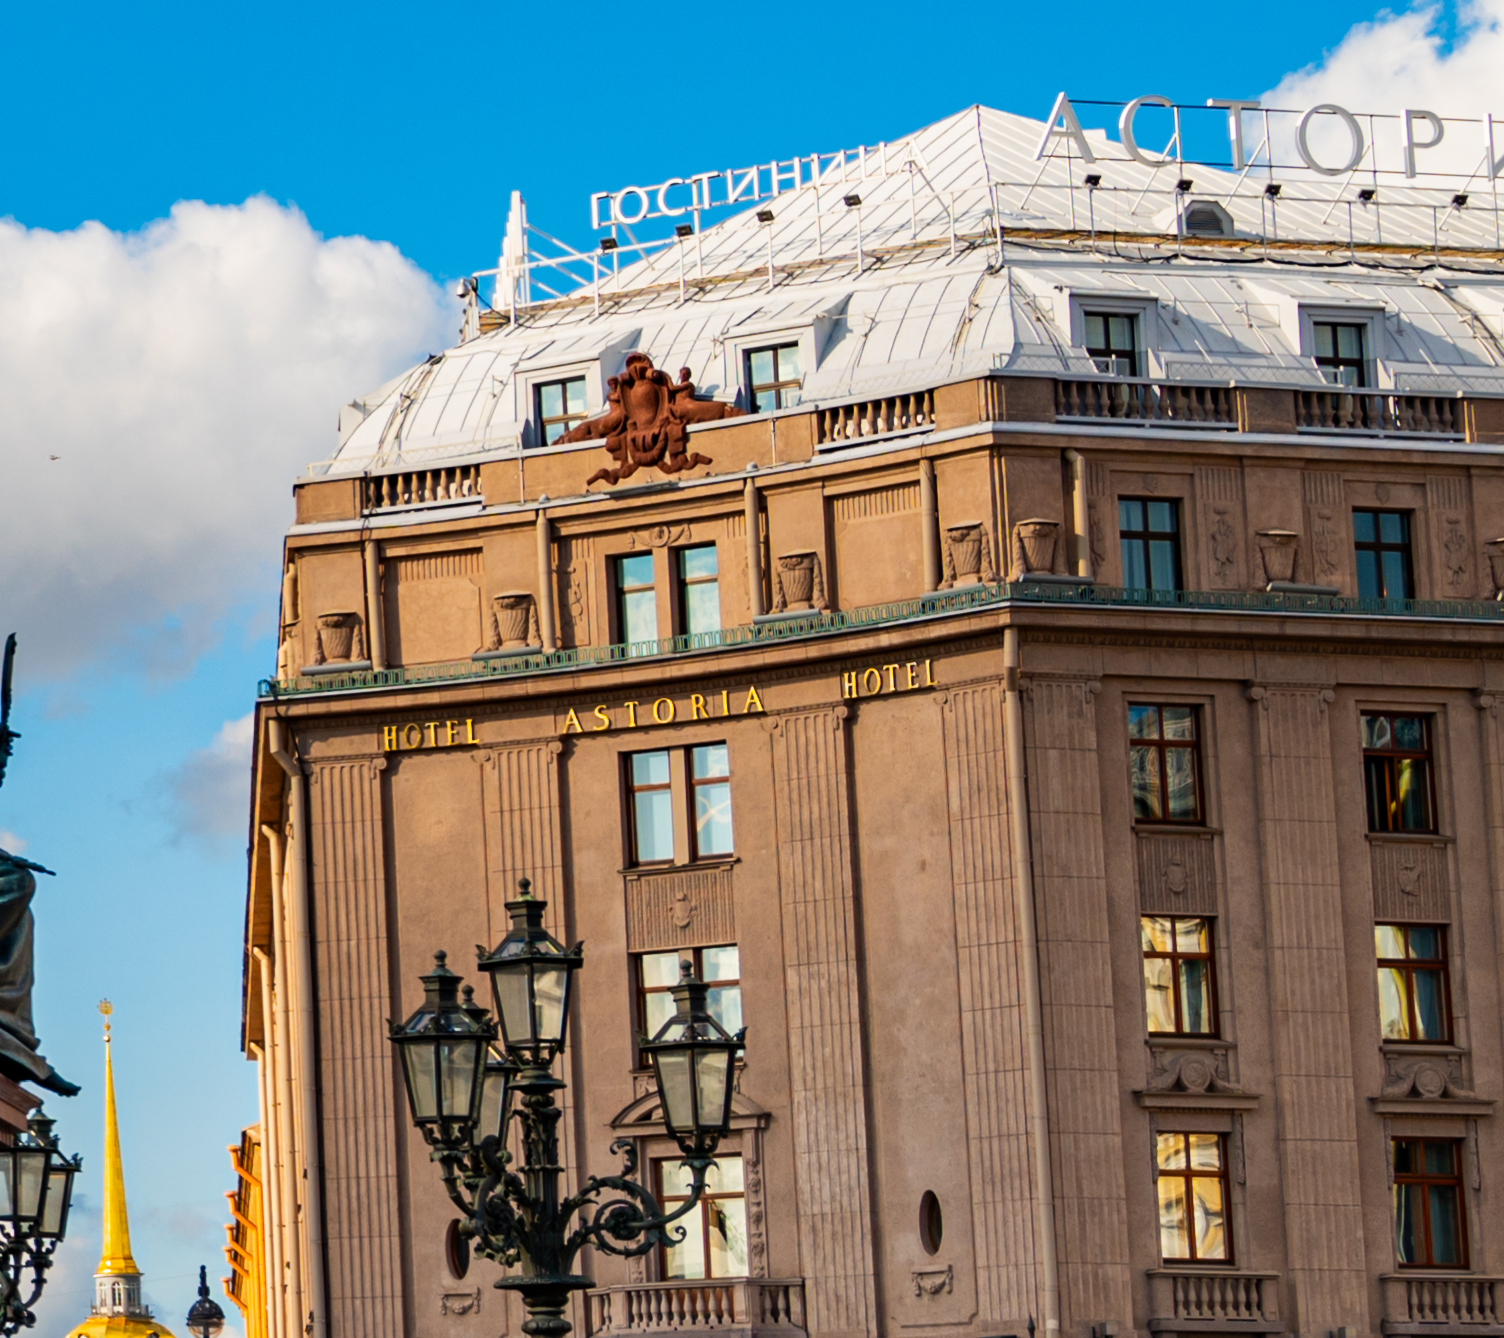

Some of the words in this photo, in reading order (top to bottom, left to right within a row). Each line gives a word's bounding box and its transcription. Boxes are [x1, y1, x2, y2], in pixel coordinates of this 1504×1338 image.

[590, 138, 929, 229] ГОСТИНИЦА
[383, 718, 480, 752] HOTEL
[563, 685, 765, 734] ASTORIA
[842, 659, 939, 699] HOTEL
